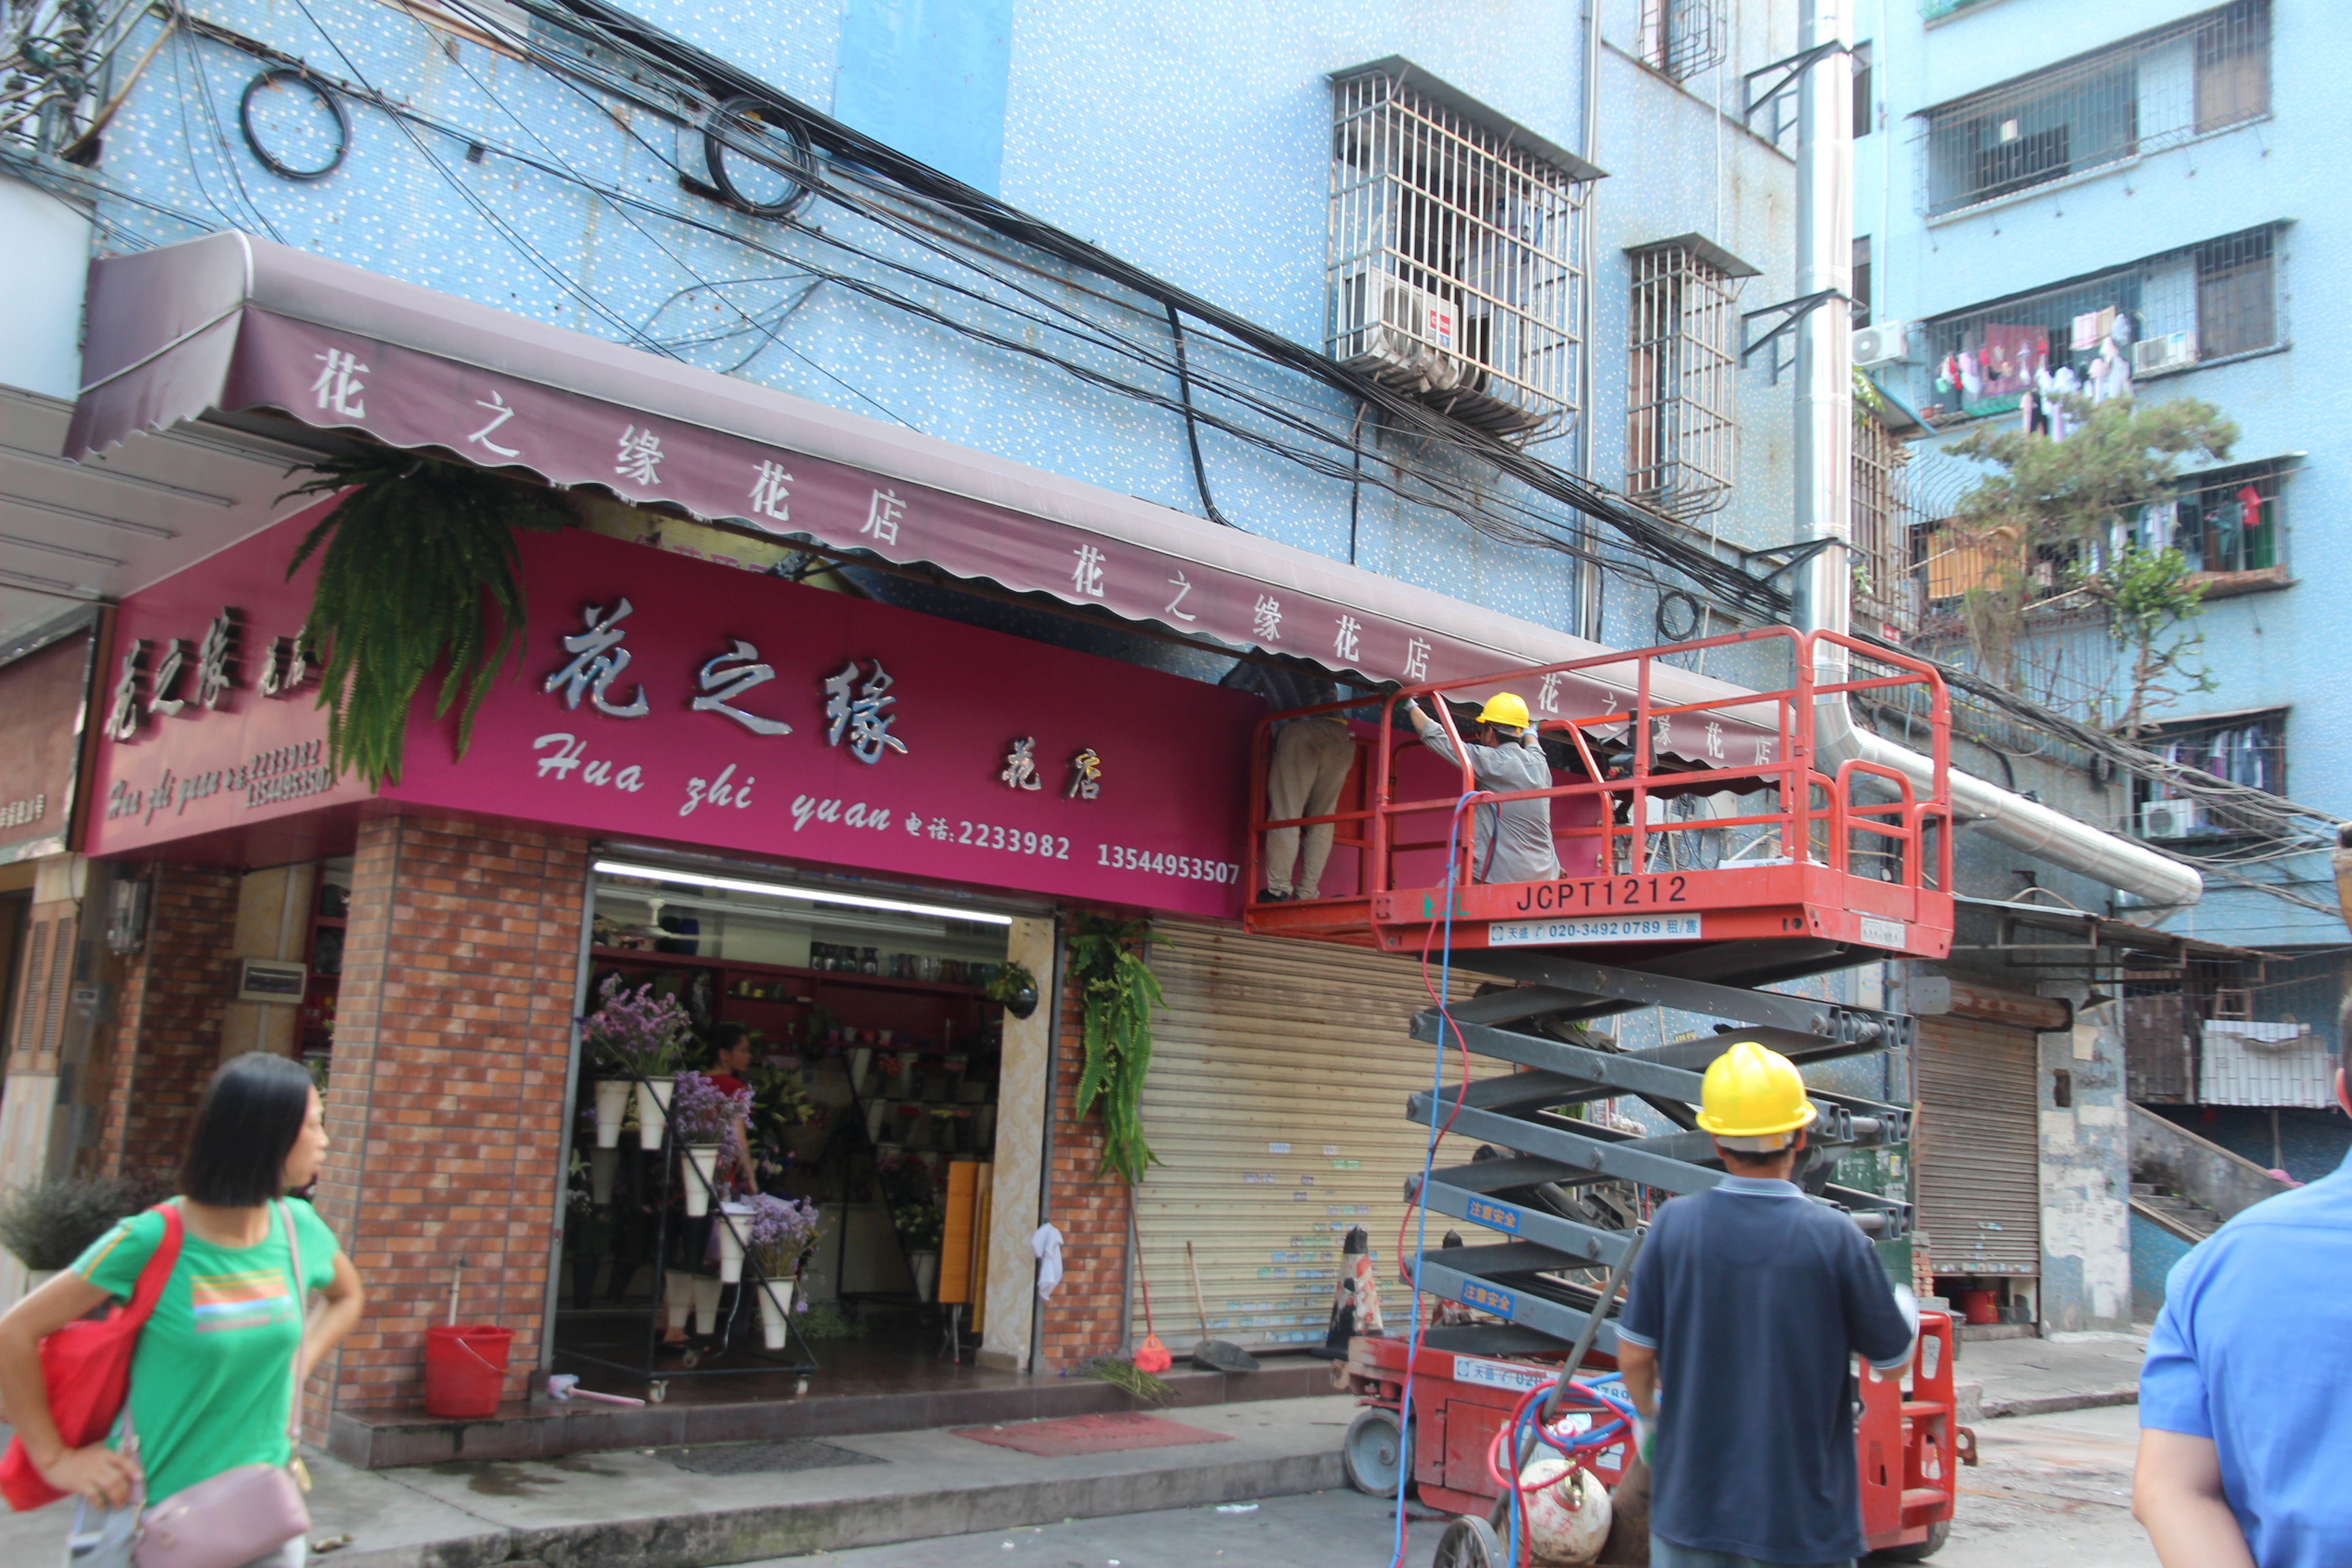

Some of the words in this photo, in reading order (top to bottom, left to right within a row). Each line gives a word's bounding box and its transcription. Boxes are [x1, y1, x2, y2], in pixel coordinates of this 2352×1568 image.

[544, 597, 909, 764] 花之缘
[1001, 736, 1102, 800] 花店
[108, 779, 142, 819] Hua
[534, 732, 645, 793] Hua
[679, 763, 755, 816] zhi
[791, 793, 891, 832] yuan
[1097, 843, 1239, 885] 13544953507
[1517, 876, 1686, 911] JCPT1212
[1622, 921, 1661, 935] 0789
[1469, 1201, 1517, 1228] 注意安全
[1464, 1284, 1511, 1311] 注意安全
